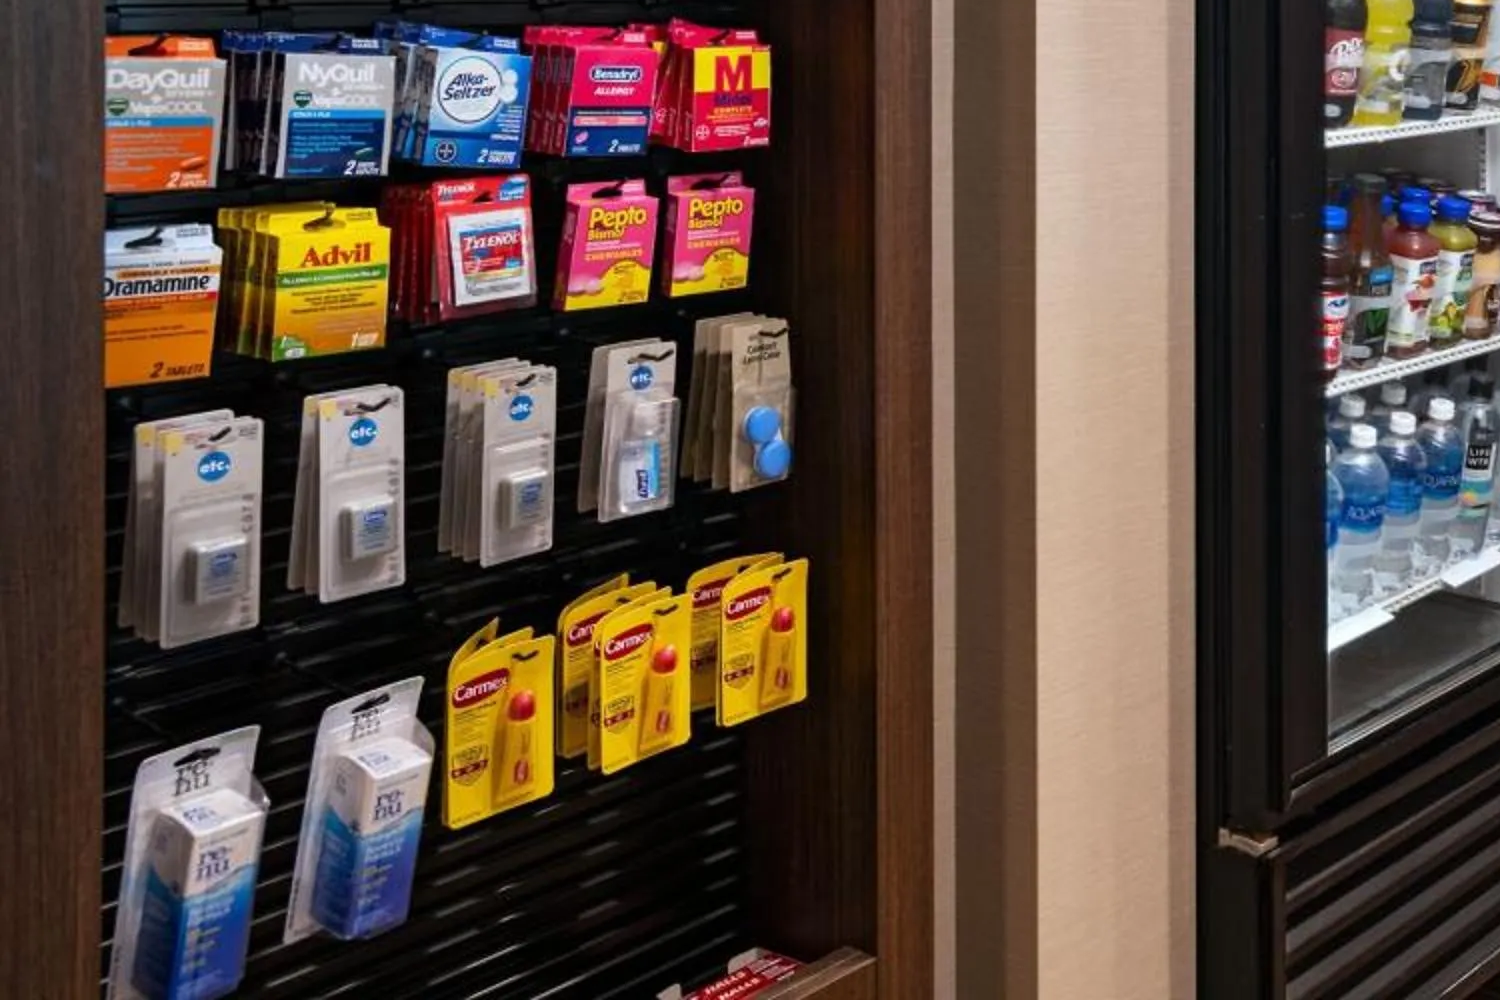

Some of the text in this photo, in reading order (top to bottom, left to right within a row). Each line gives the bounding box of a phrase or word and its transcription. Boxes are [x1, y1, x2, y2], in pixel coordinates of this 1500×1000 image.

[105, 68, 210, 95] DayQuil
[300, 63, 376, 90] NyQuil
[450, 72, 489, 89] Alka-
[715, 55, 753, 92] M
[442, 84, 497, 102] Seltzer
[594, 85, 636, 97] ALLERGY
[478, 148, 489, 164] 2
[609, 138, 619, 153] 2
[344, 159, 357, 176] 2
[167, 171, 181, 188] 2
[588, 206, 647, 228] Pepto
[689, 196, 743, 219] Pepto
[688, 215, 723, 229] Bismol
[463, 231, 521, 252] TYLENOL
[587, 227, 625, 241] Bismol
[300, 242, 374, 268] Advil
[104, 275, 211, 299] Dramamine
[150, 361, 163, 378] 2
[350, 423, 379, 442] etc.
[198, 457, 231, 474] etc.
[692, 584, 723, 605] Carm
[726, 591, 770, 617] Carmex
[604, 627, 654, 658] Carmex
[453, 674, 508, 704] Carmex
[703, 970, 747, 995] HALLS
[718, 977, 761, 1000] HALLS
